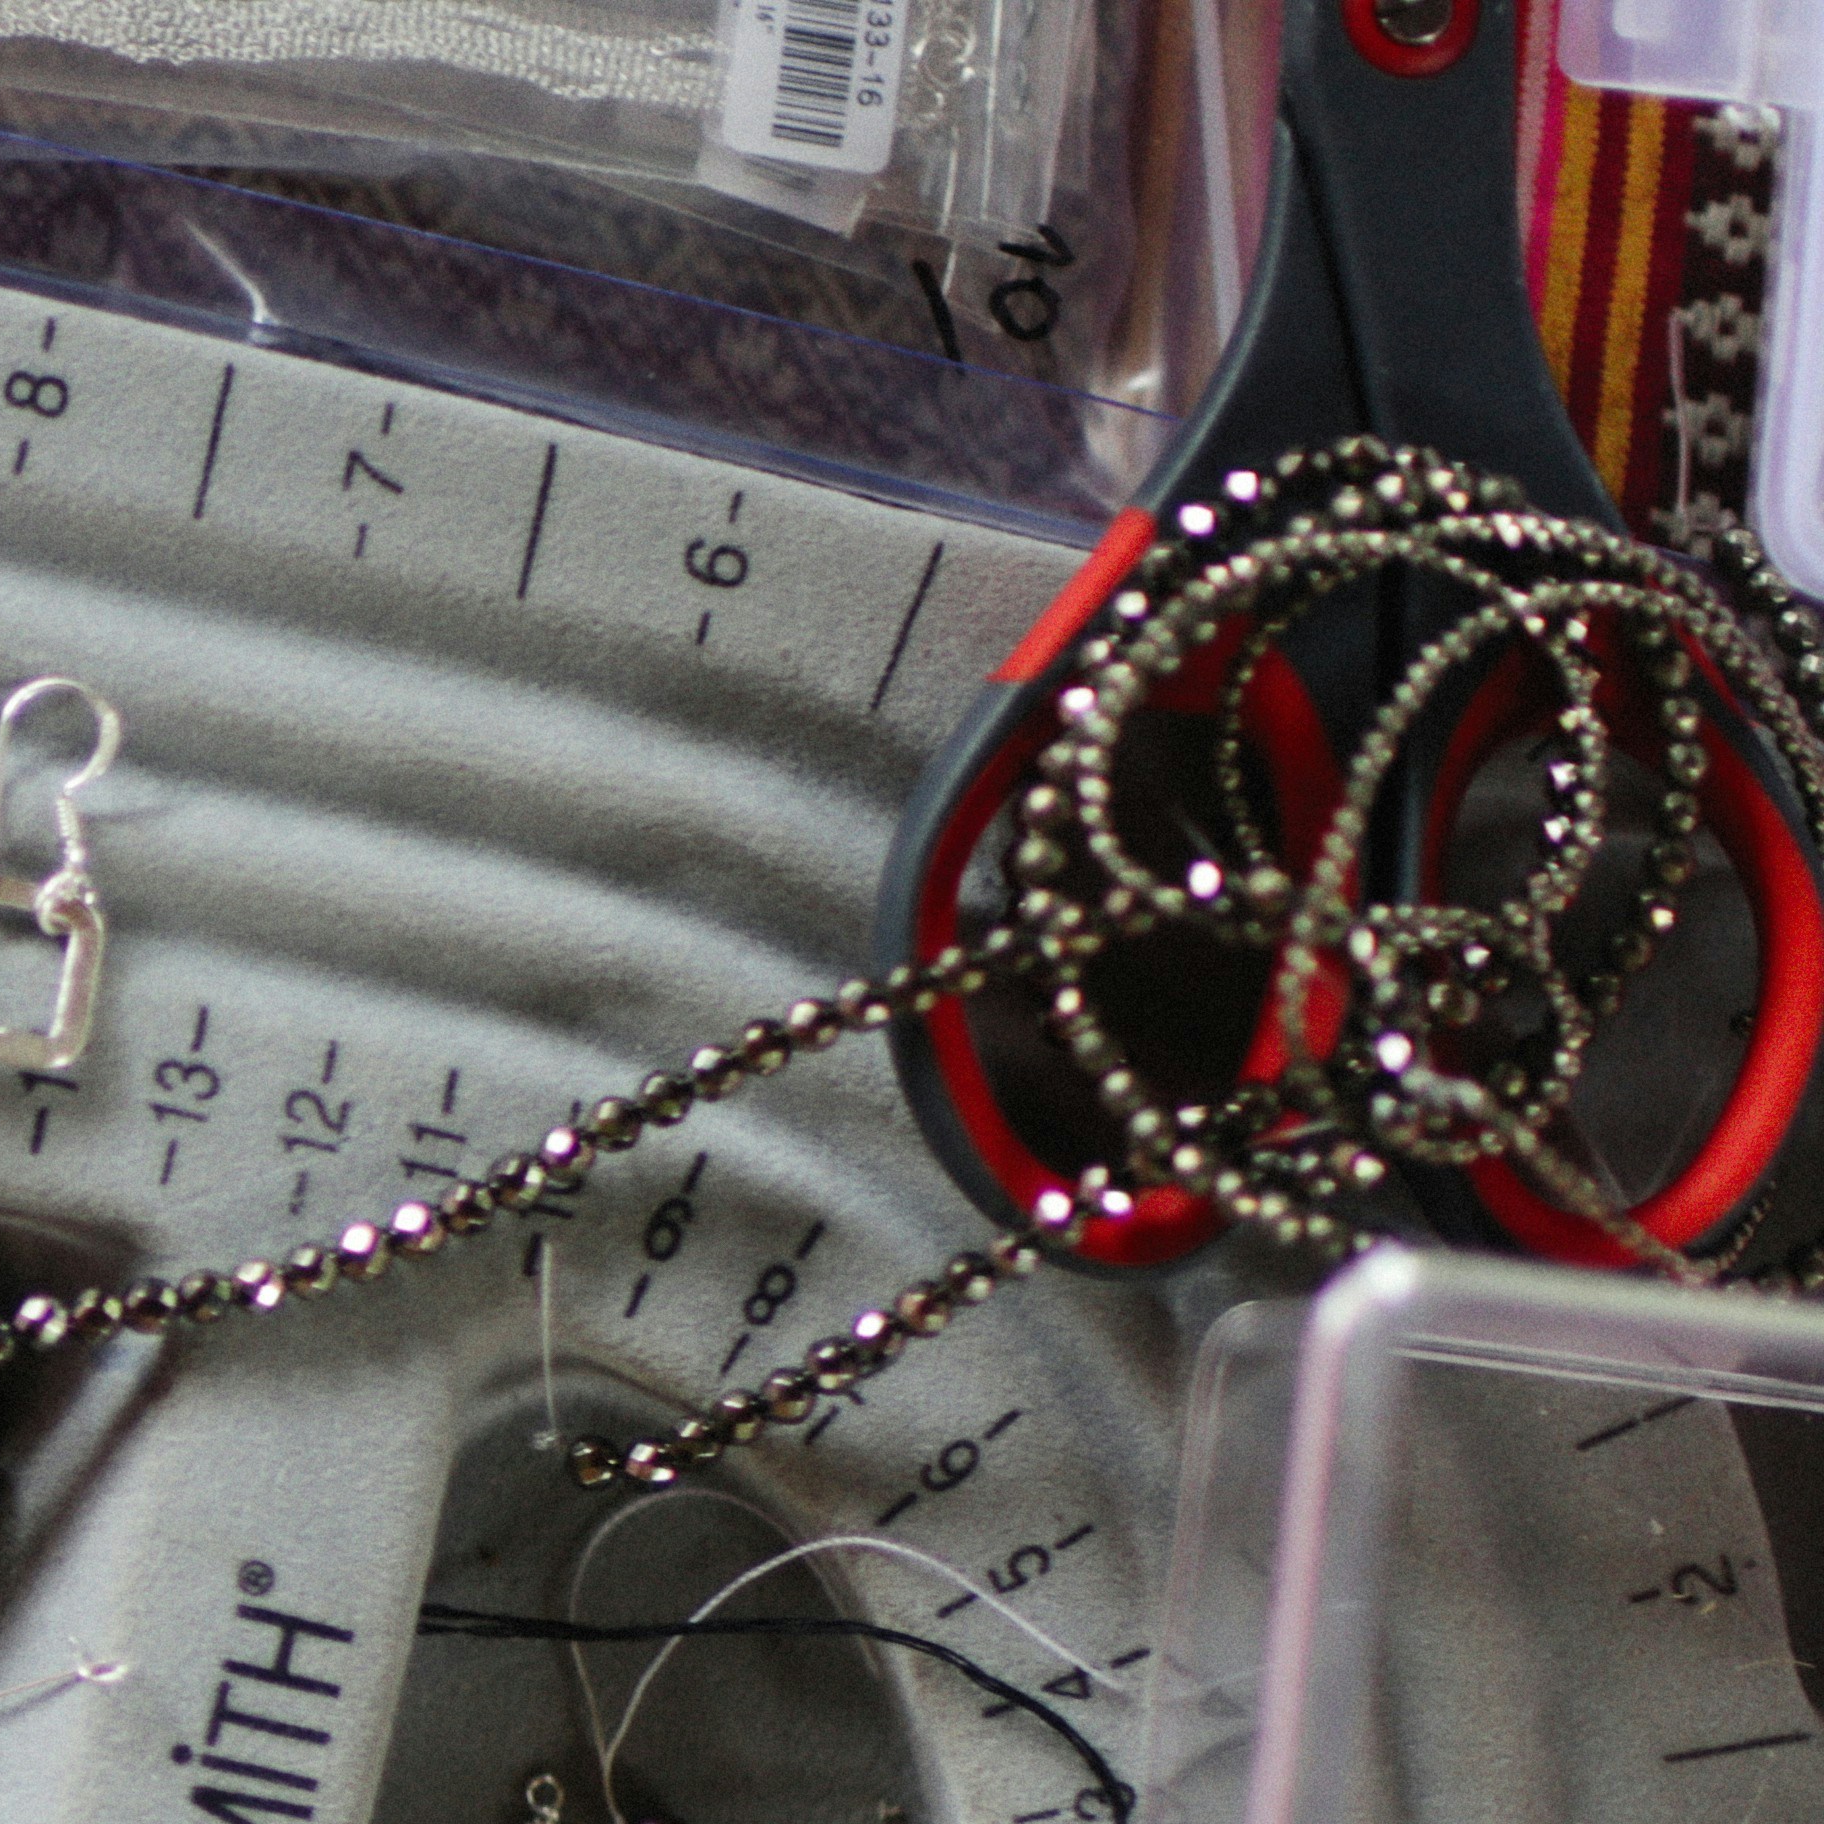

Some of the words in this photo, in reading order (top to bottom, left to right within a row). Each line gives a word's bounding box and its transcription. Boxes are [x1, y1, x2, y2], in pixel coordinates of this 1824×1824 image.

[2, 369, 71, 420] 8
[341, 448, 405, 496] 7
[683, 537, 751, 590] 6
[148, 1057, 222, 1124] 13
[279, 1087, 354, 1155] 12
[398, 1120, 468, 1181] 11
[743, 1263, 798, 1327] 8
[986, 1542, 1053, 1595] 5
[1673, 1551, 1739, 1607] 2
